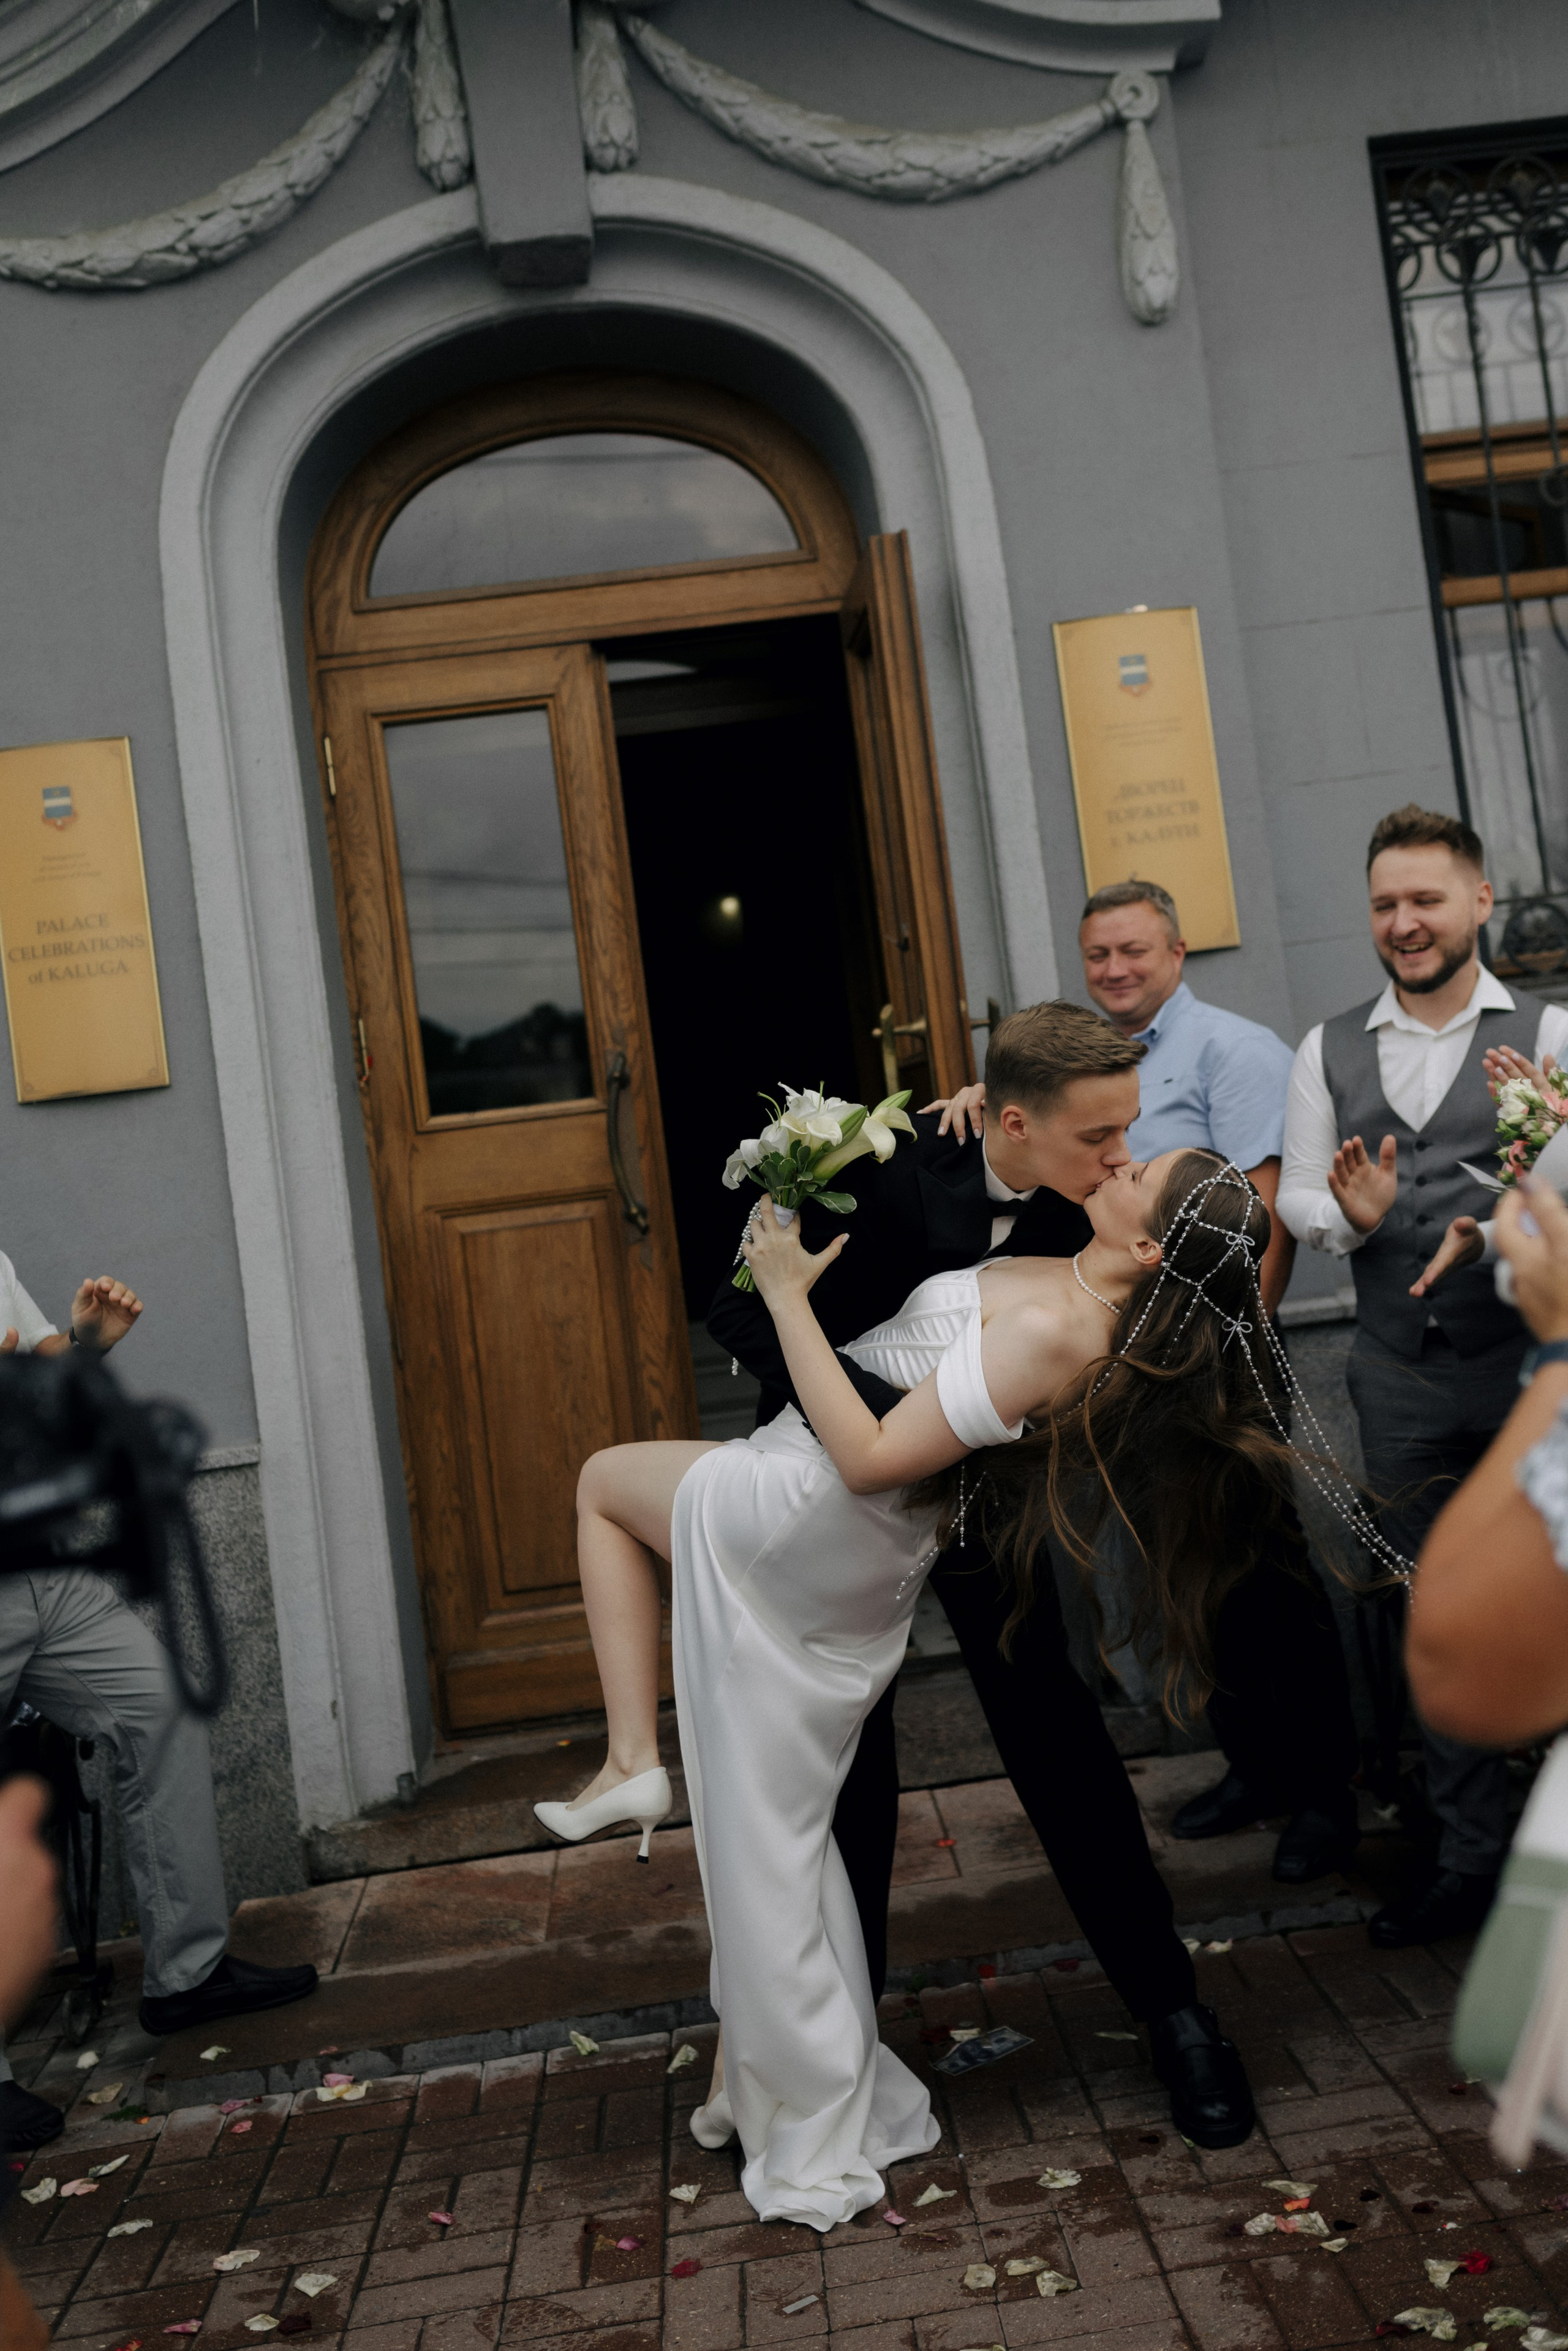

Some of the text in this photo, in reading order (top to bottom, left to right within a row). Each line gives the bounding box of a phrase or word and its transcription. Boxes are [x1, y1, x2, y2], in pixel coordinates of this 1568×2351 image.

[36, 913, 109, 935] PALACE
[7, 933, 146, 963] CELEBRATIONS
[28, 960, 129, 984] of KALUGA
